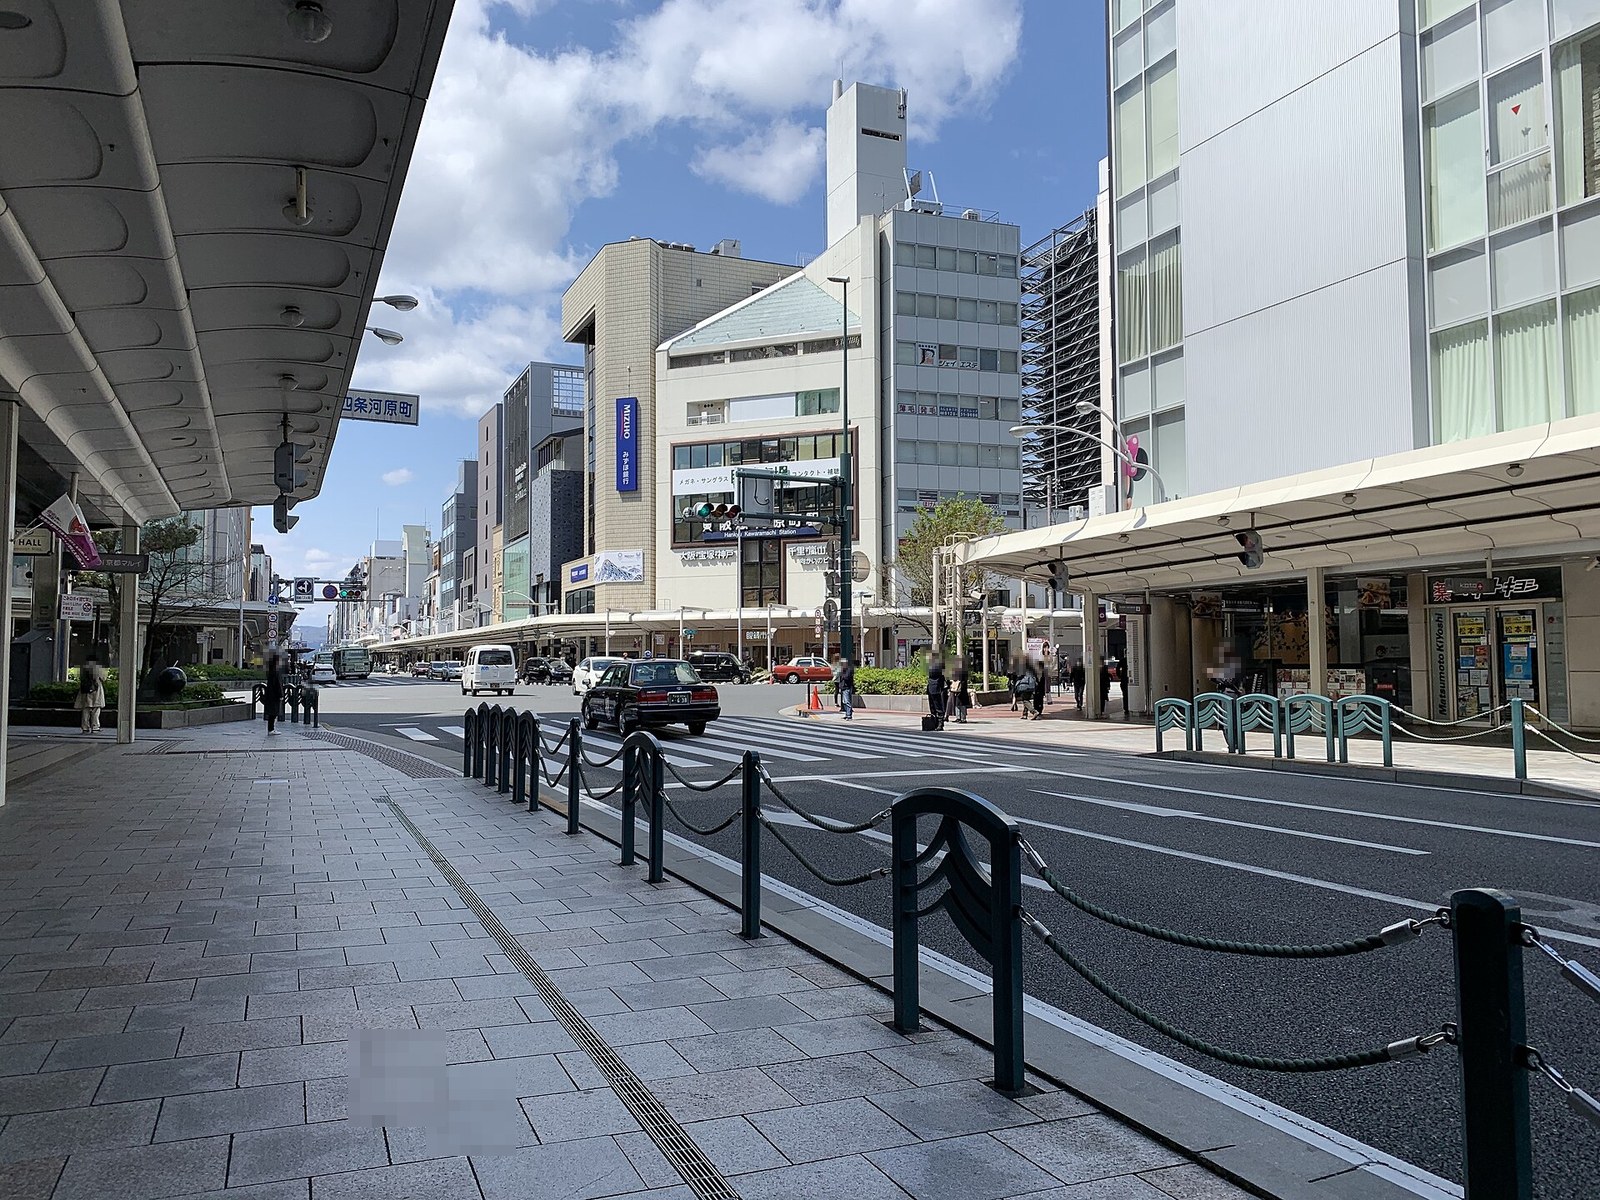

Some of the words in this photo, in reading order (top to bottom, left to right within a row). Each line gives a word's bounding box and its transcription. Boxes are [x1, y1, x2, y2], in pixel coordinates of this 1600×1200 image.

[342, 396, 413, 418] 四条河原町
[623, 404, 631, 440] MIZUHO
[18, 539, 42, 547] HALL
